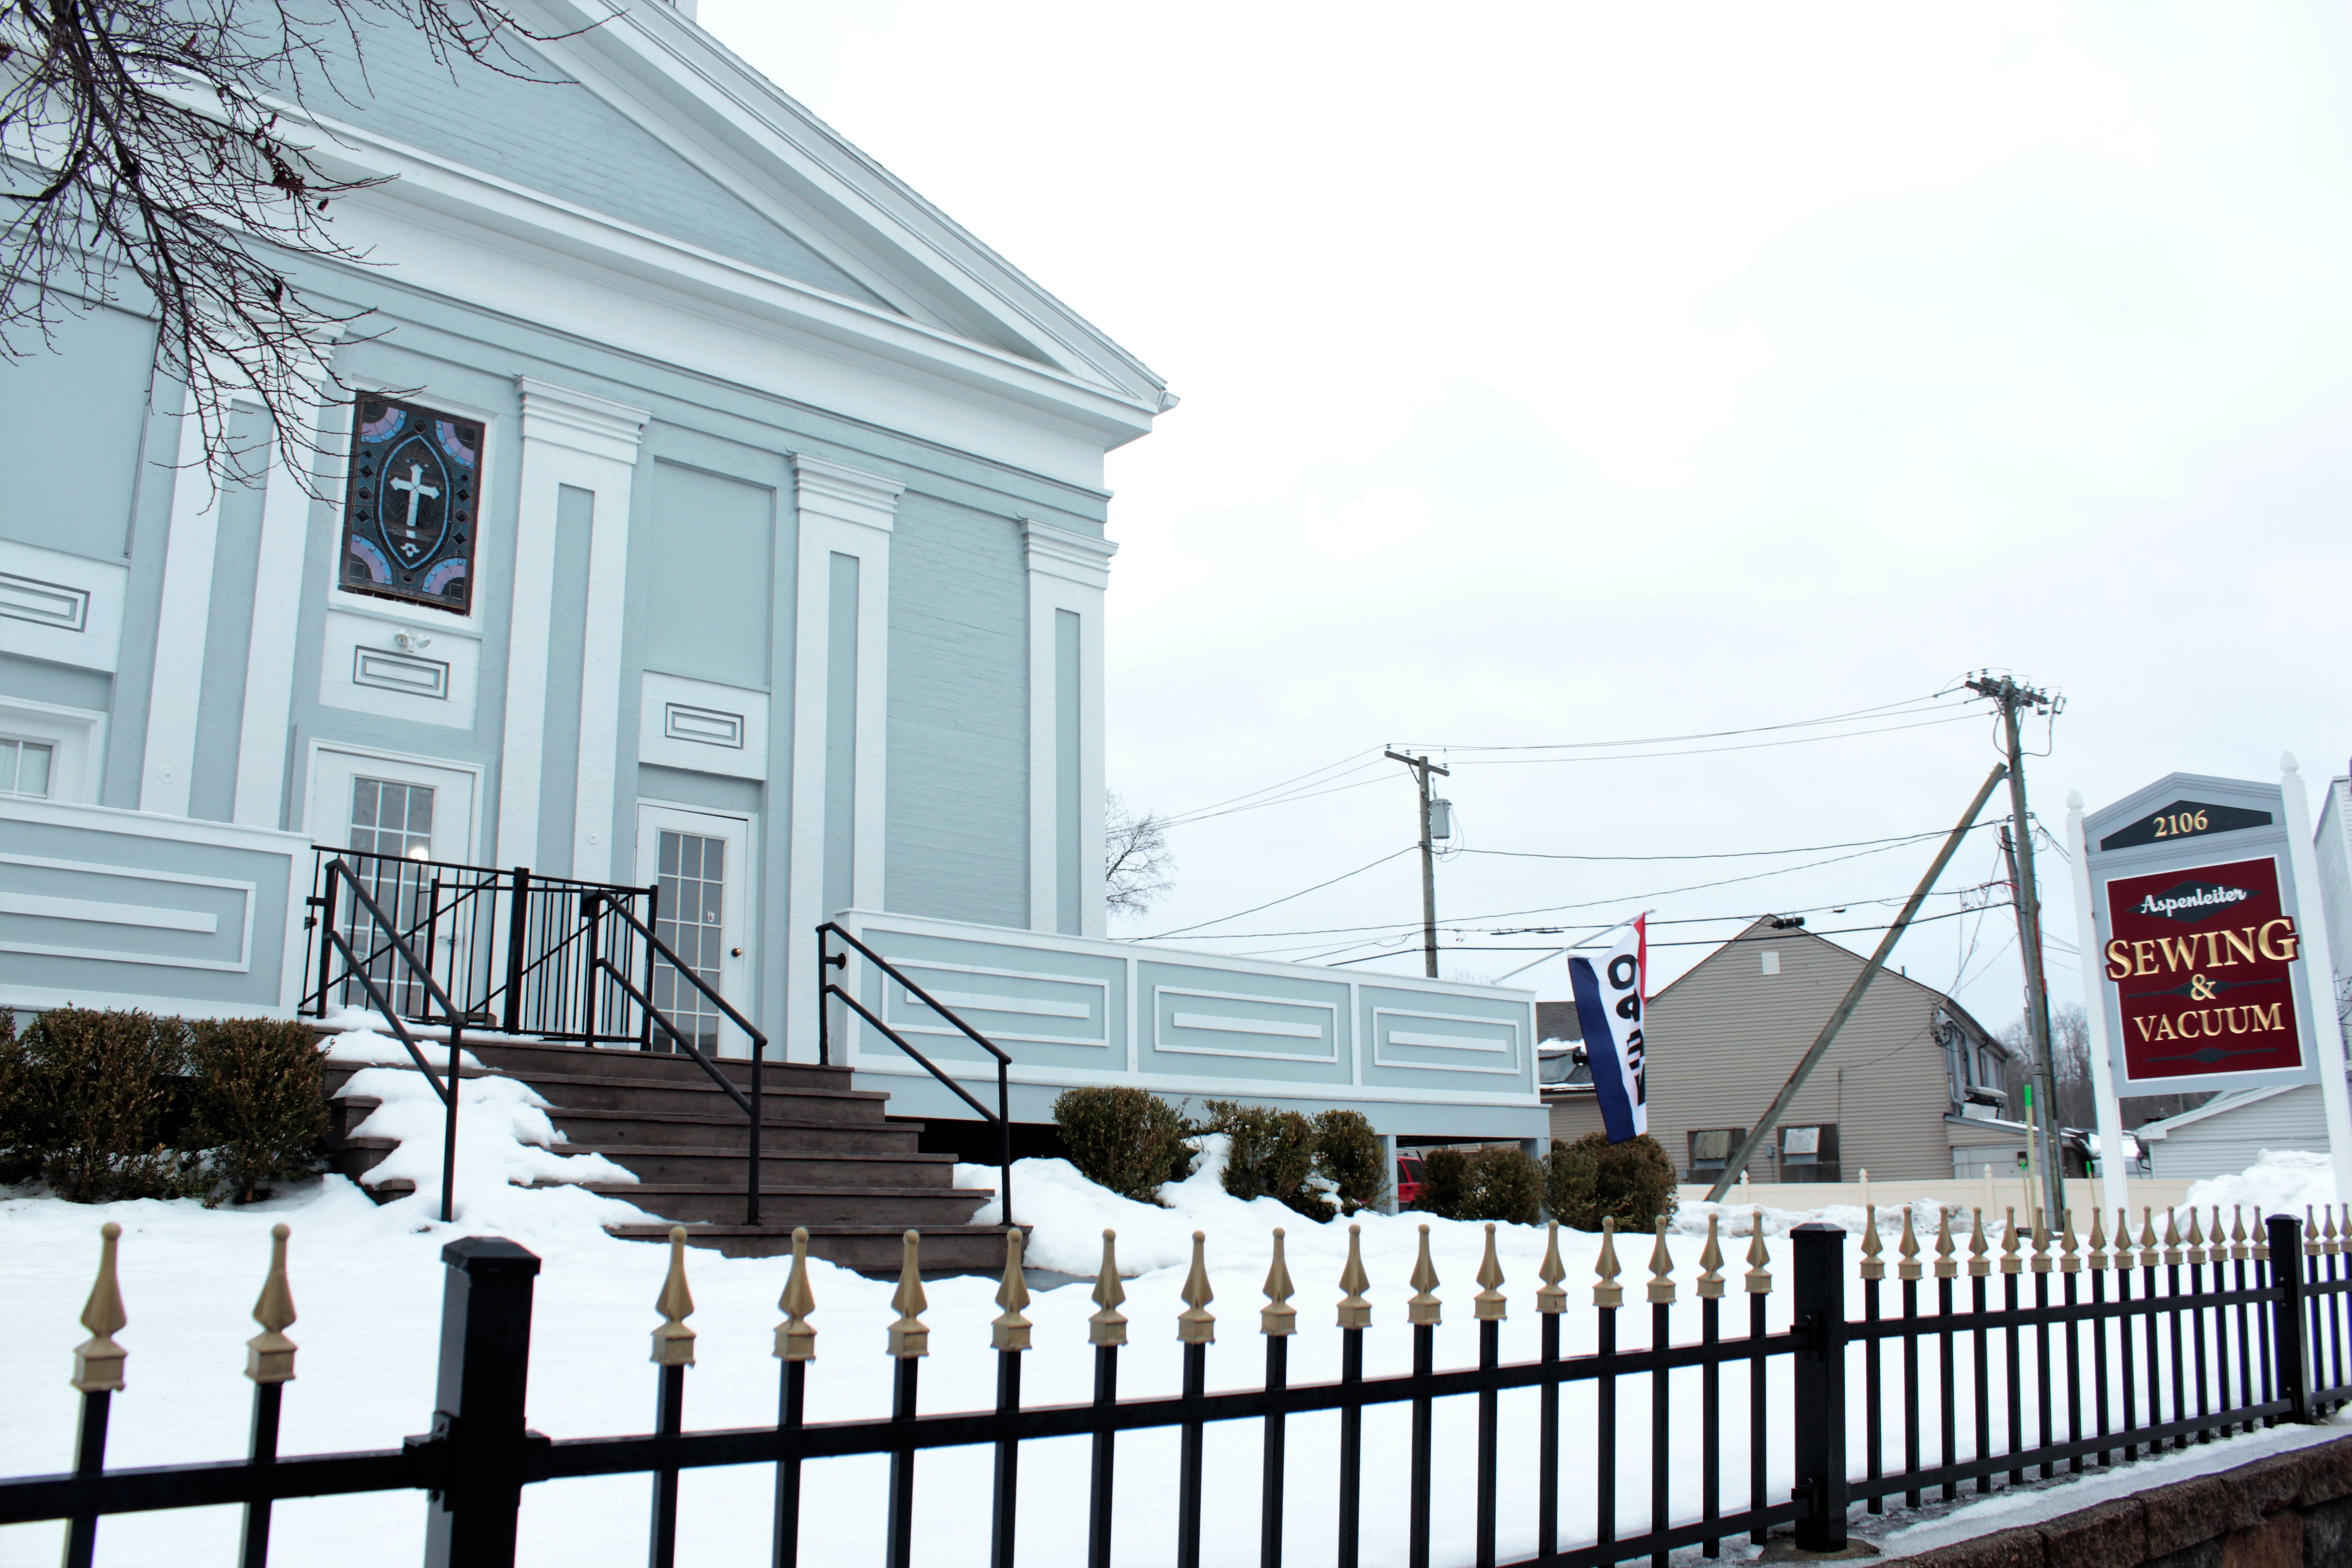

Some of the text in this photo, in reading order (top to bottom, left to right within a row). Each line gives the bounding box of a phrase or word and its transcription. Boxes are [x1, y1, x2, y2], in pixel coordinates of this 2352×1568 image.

[2153, 809, 2209, 838] 2106
[2140, 886, 2247, 917] Aspenleiter
[2107, 919, 2297, 979] SEWING
[2190, 974, 2216, 1001] &
[2133, 1003, 2285, 1042] VACUUM
